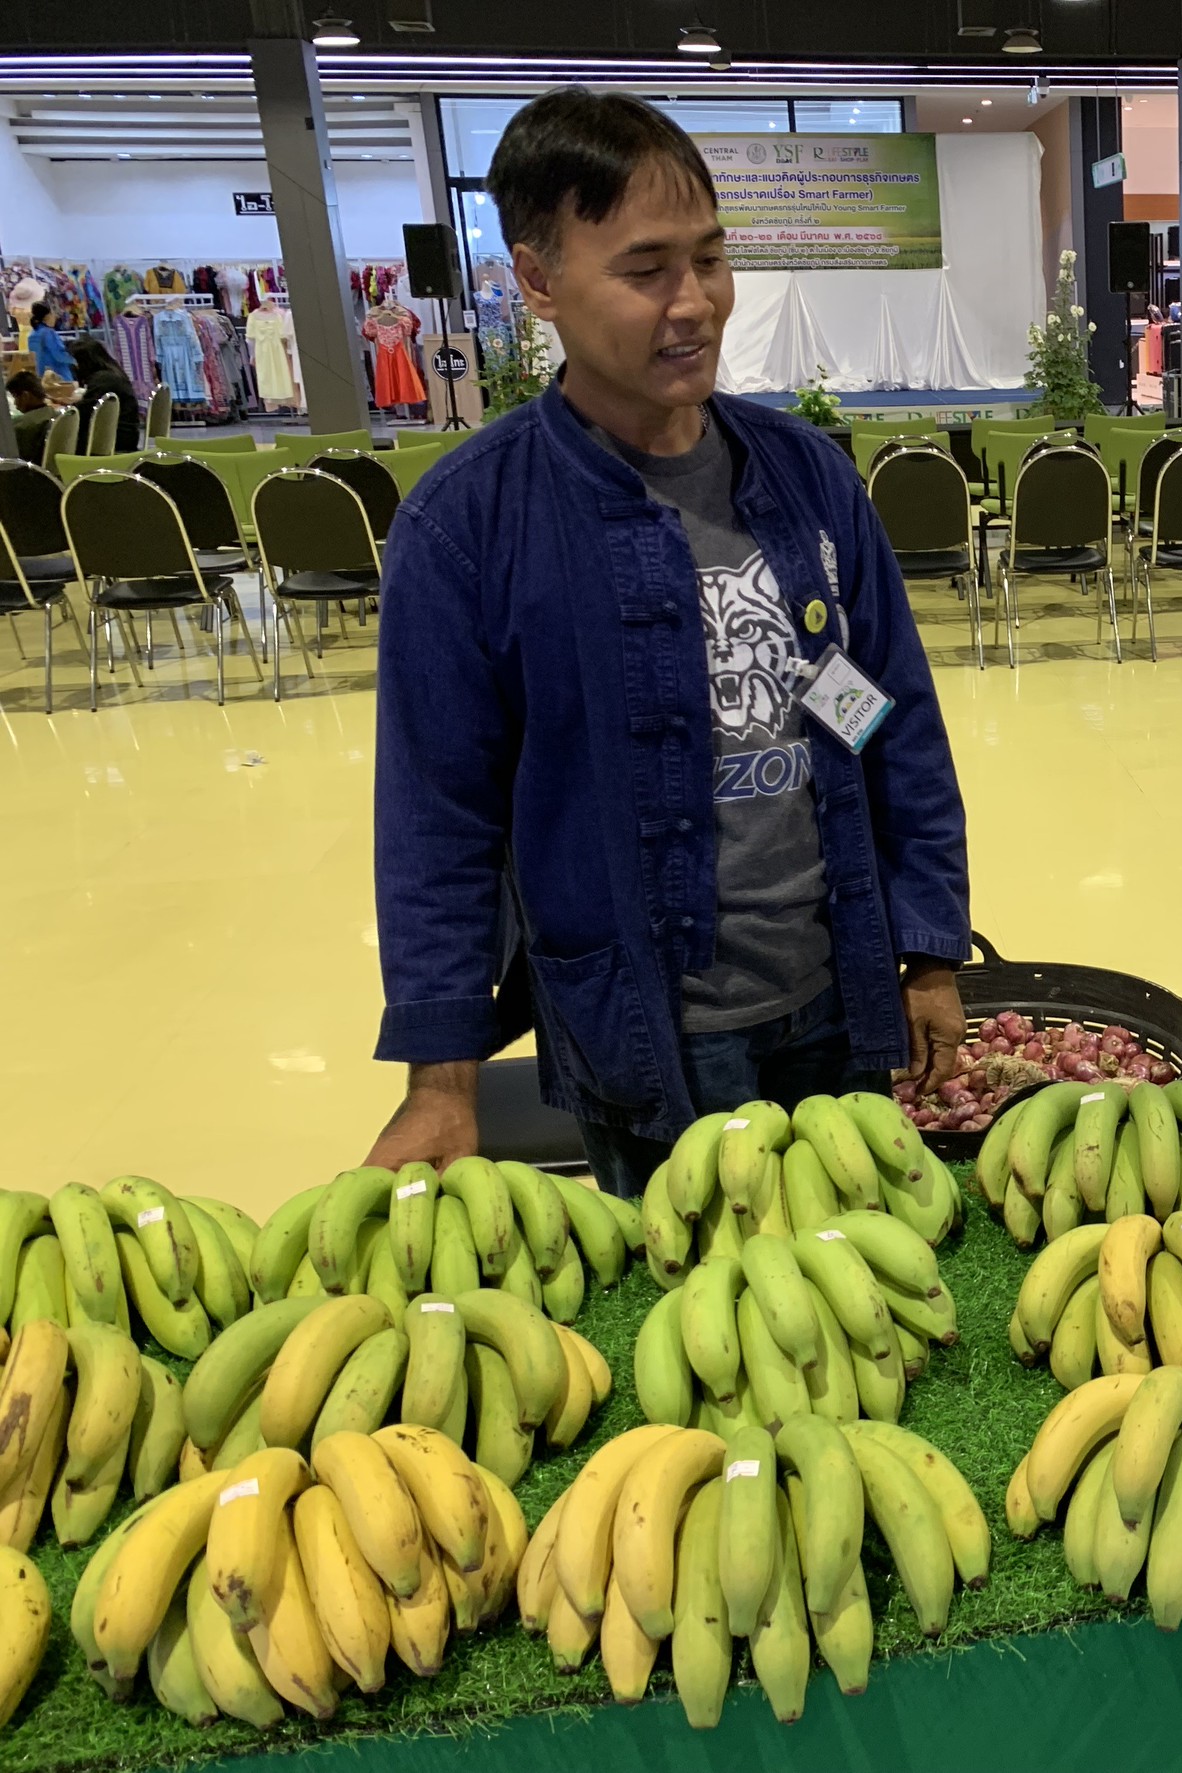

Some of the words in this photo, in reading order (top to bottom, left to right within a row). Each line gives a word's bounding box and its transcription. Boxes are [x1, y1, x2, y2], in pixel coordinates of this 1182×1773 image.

[235, 194, 274, 211] ไอ-โ
[798, 190, 829, 199] Smart
[832, 189, 873, 200] Farmer)
[842, 693, 878, 737] VISITOR
[713, 742, 811, 803] ZON
